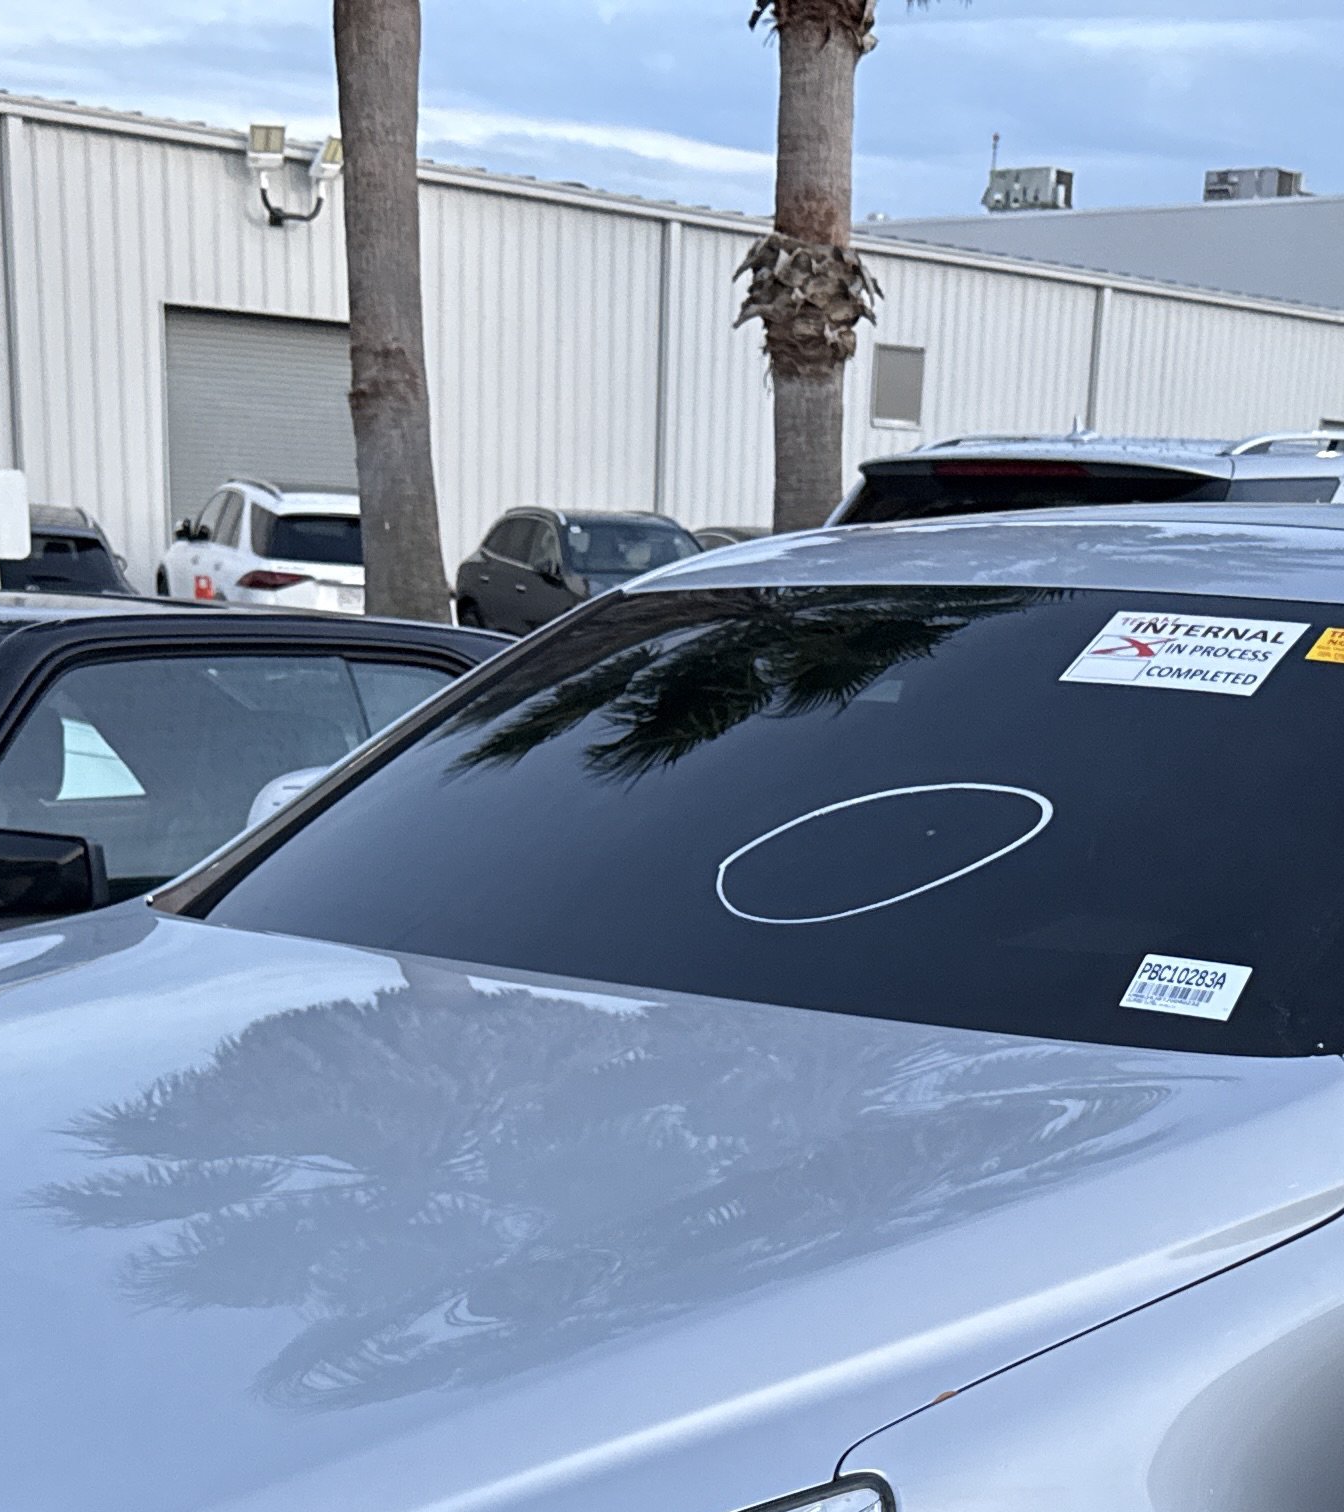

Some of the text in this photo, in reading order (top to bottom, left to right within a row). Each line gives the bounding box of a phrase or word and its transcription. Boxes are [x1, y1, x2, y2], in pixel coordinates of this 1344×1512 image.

[1131, 621, 1286, 645] INTERNAL
[1165, 643, 1272, 662] IN PROCESS
[1145, 665, 1258, 686] COMPLETED
[1138, 962, 1227, 990] PBC10283A
